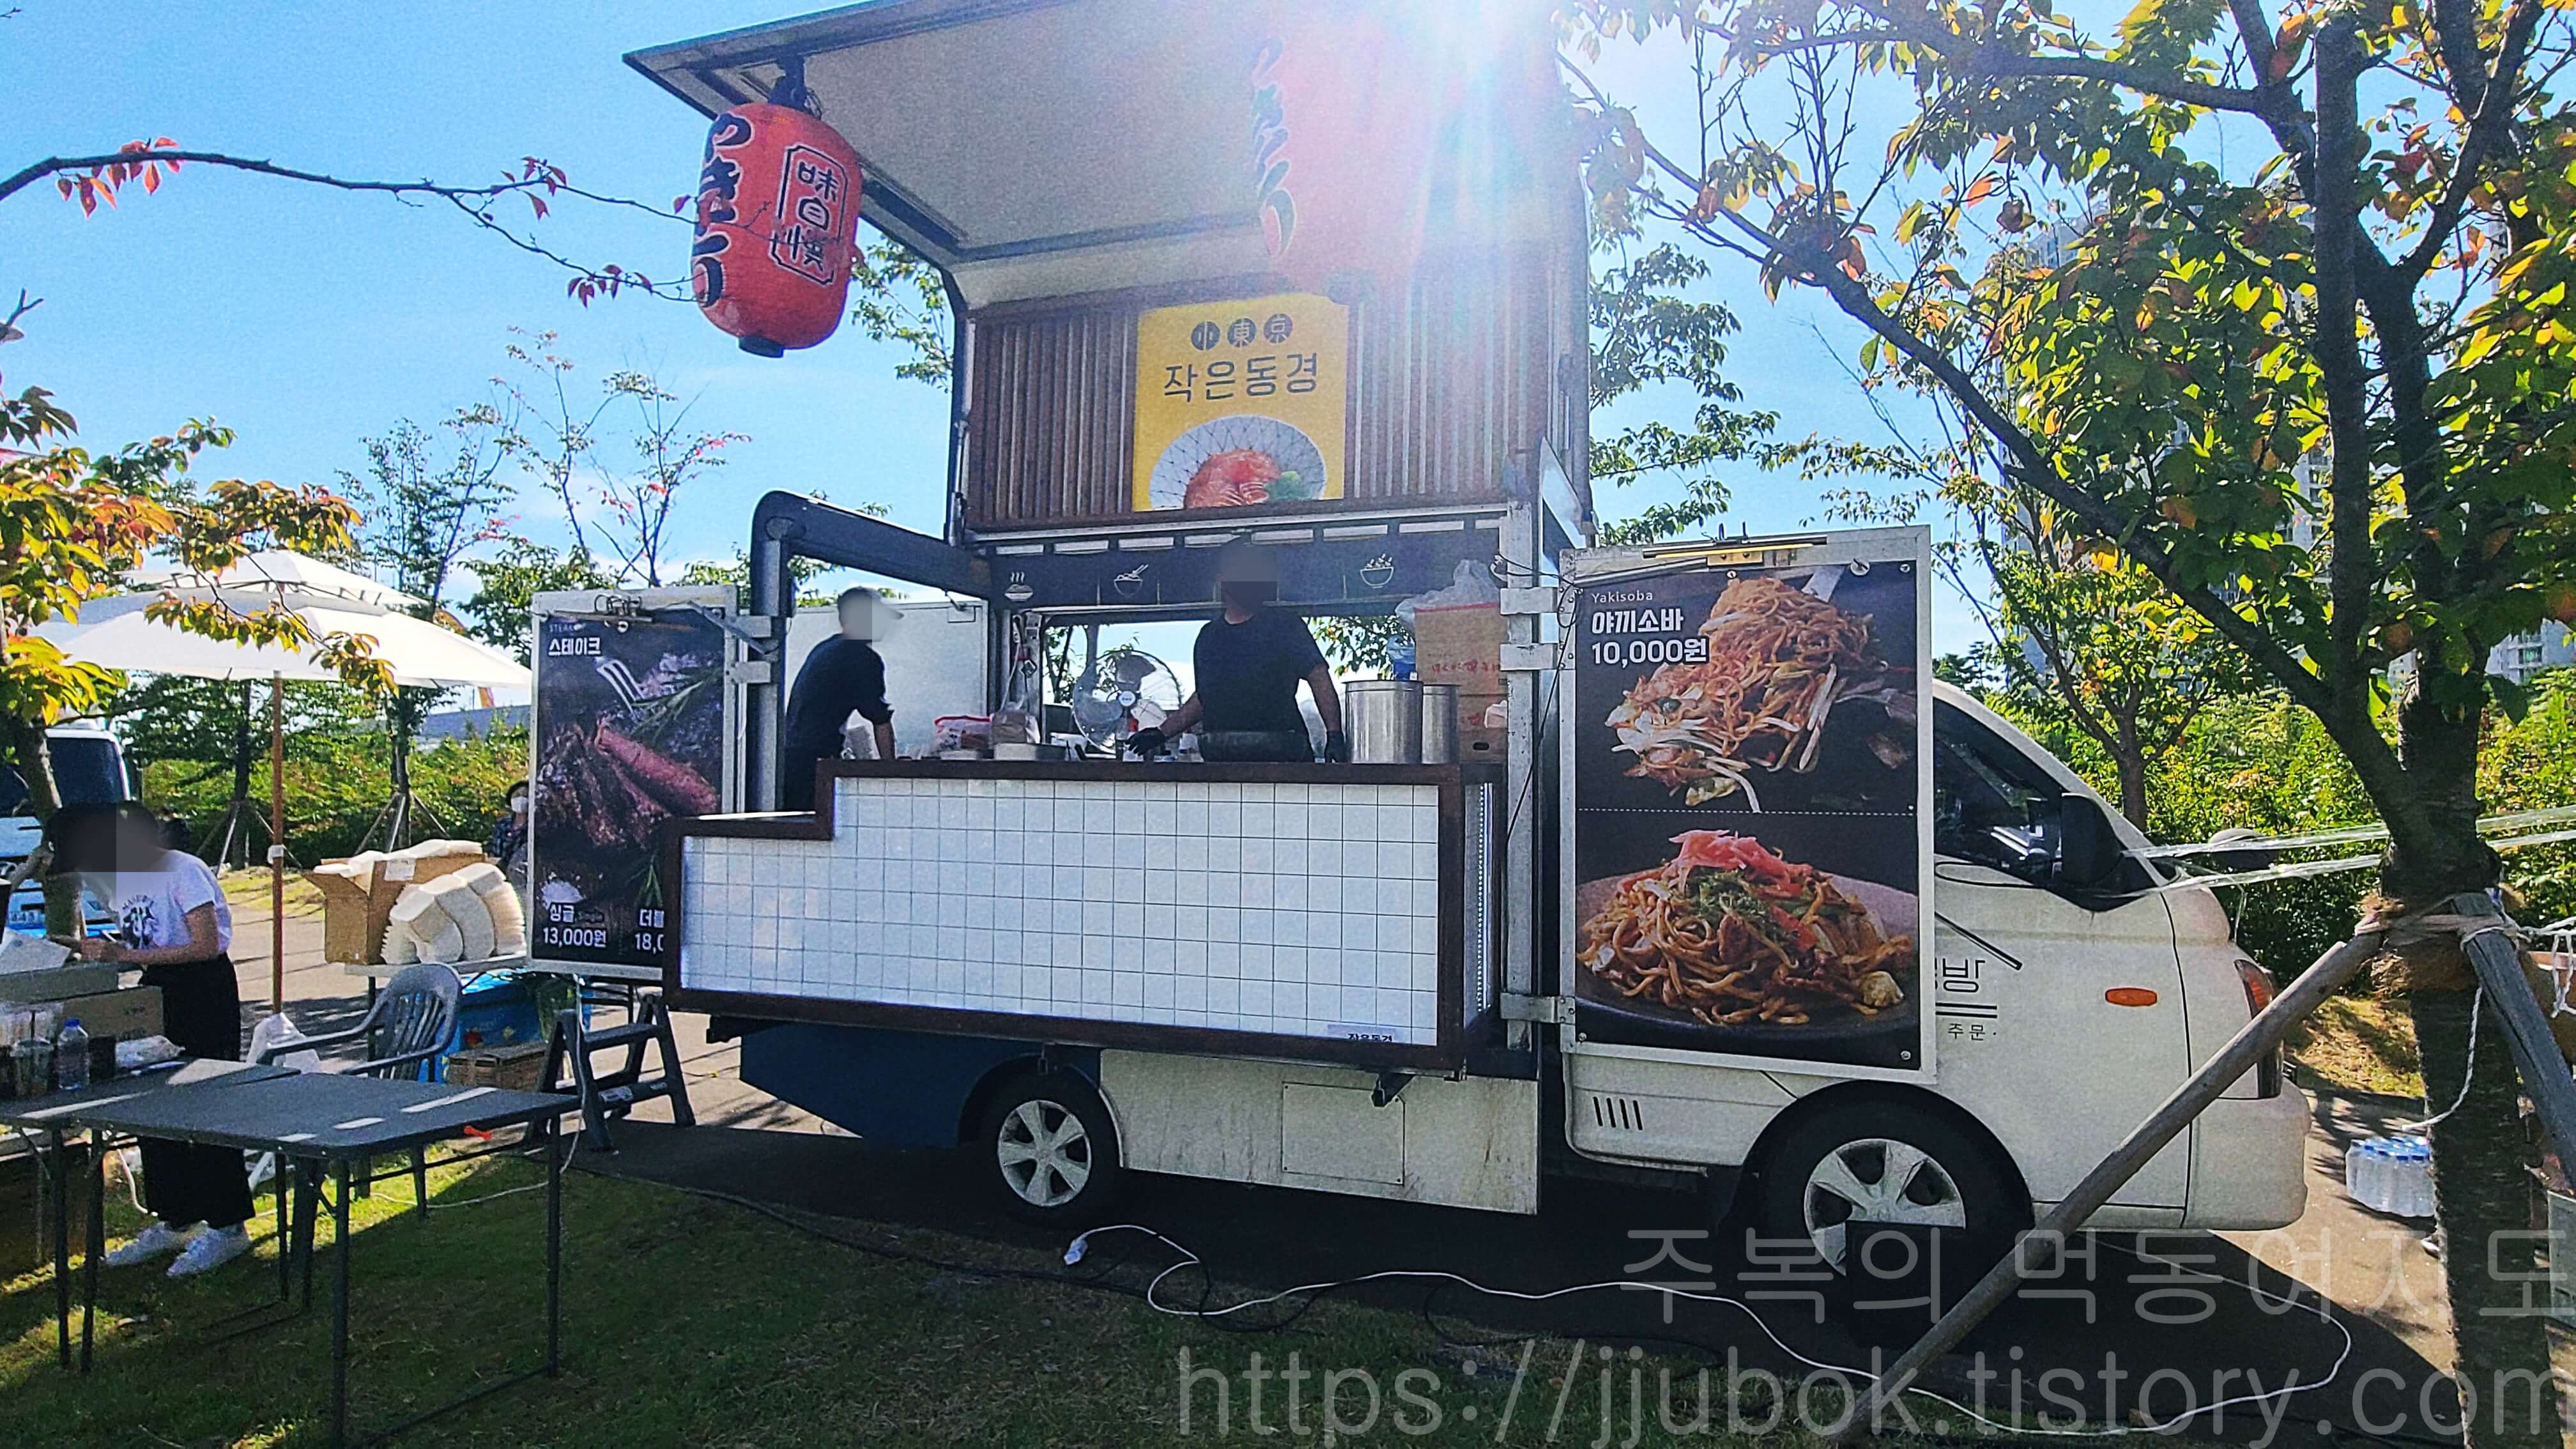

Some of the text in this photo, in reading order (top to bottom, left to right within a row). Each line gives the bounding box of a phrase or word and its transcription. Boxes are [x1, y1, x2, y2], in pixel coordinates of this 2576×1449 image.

[1192, 314, 1292, 350] 小東京
[1163, 352, 1318, 403] 작은동경
[1591, 590, 1653, 603] Yakisoba
[1591, 608, 1684, 634] 야끼소바
[548, 637, 601, 656] 스테이크
[1591, 638, 1706, 668] 10,000원
[542, 926, 606, 948] 13,000원
